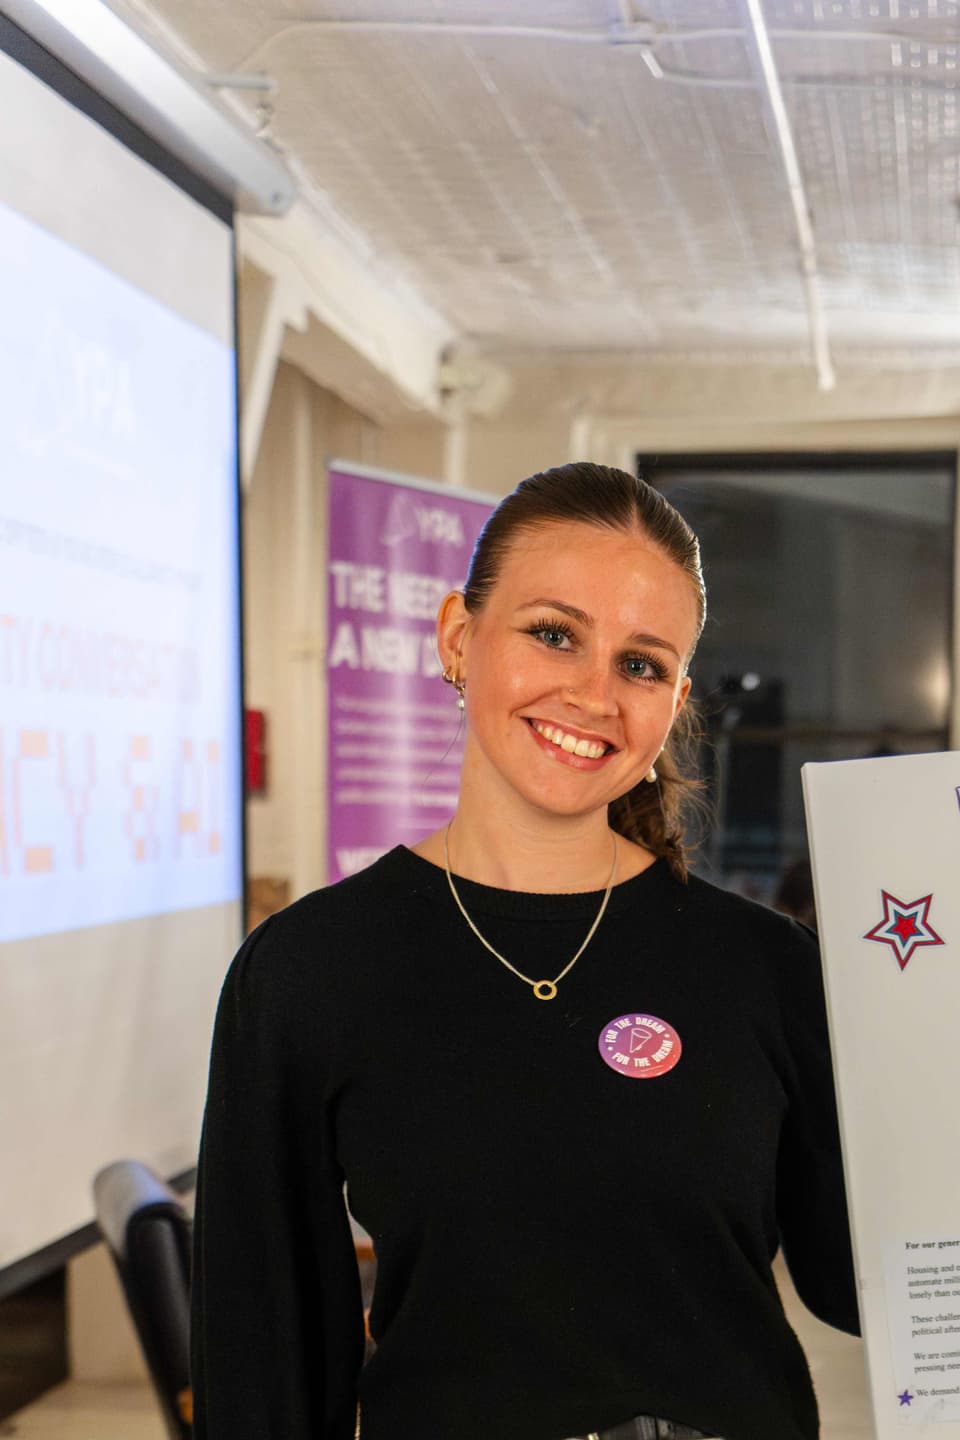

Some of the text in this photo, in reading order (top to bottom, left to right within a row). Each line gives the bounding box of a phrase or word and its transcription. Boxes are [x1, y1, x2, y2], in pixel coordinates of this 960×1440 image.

[330, 561, 385, 613] THE
[329, 622, 359, 668] A
[605, 1016, 666, 1043] FOR THE DREAM
[612, 1039, 673, 1067] FOR THE DREAM
[905, 1240, 919, 1249] For
